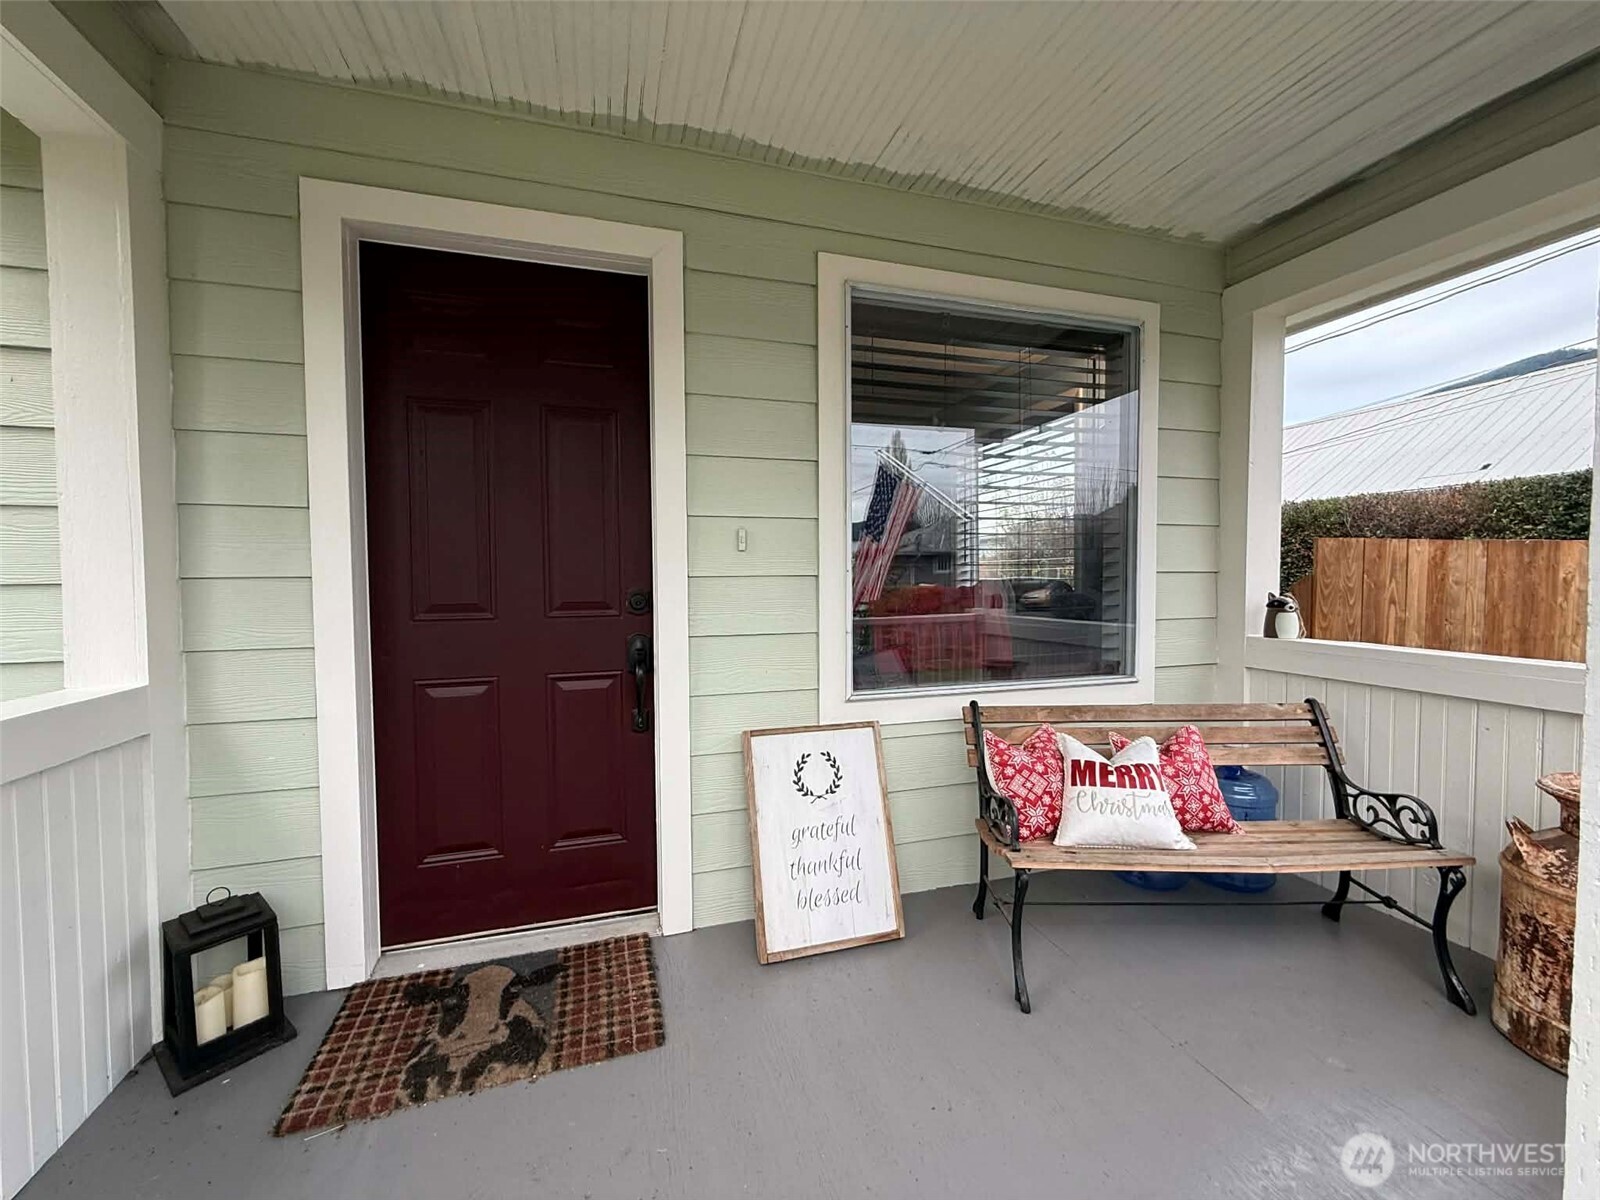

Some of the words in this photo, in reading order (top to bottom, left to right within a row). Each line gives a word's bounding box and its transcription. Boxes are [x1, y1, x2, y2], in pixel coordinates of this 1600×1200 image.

[1070, 758, 1166, 792] MERRY
[790, 813, 857, 849] grateful
[789, 847, 863, 880] thankful
[796, 880, 863, 912] blessed
